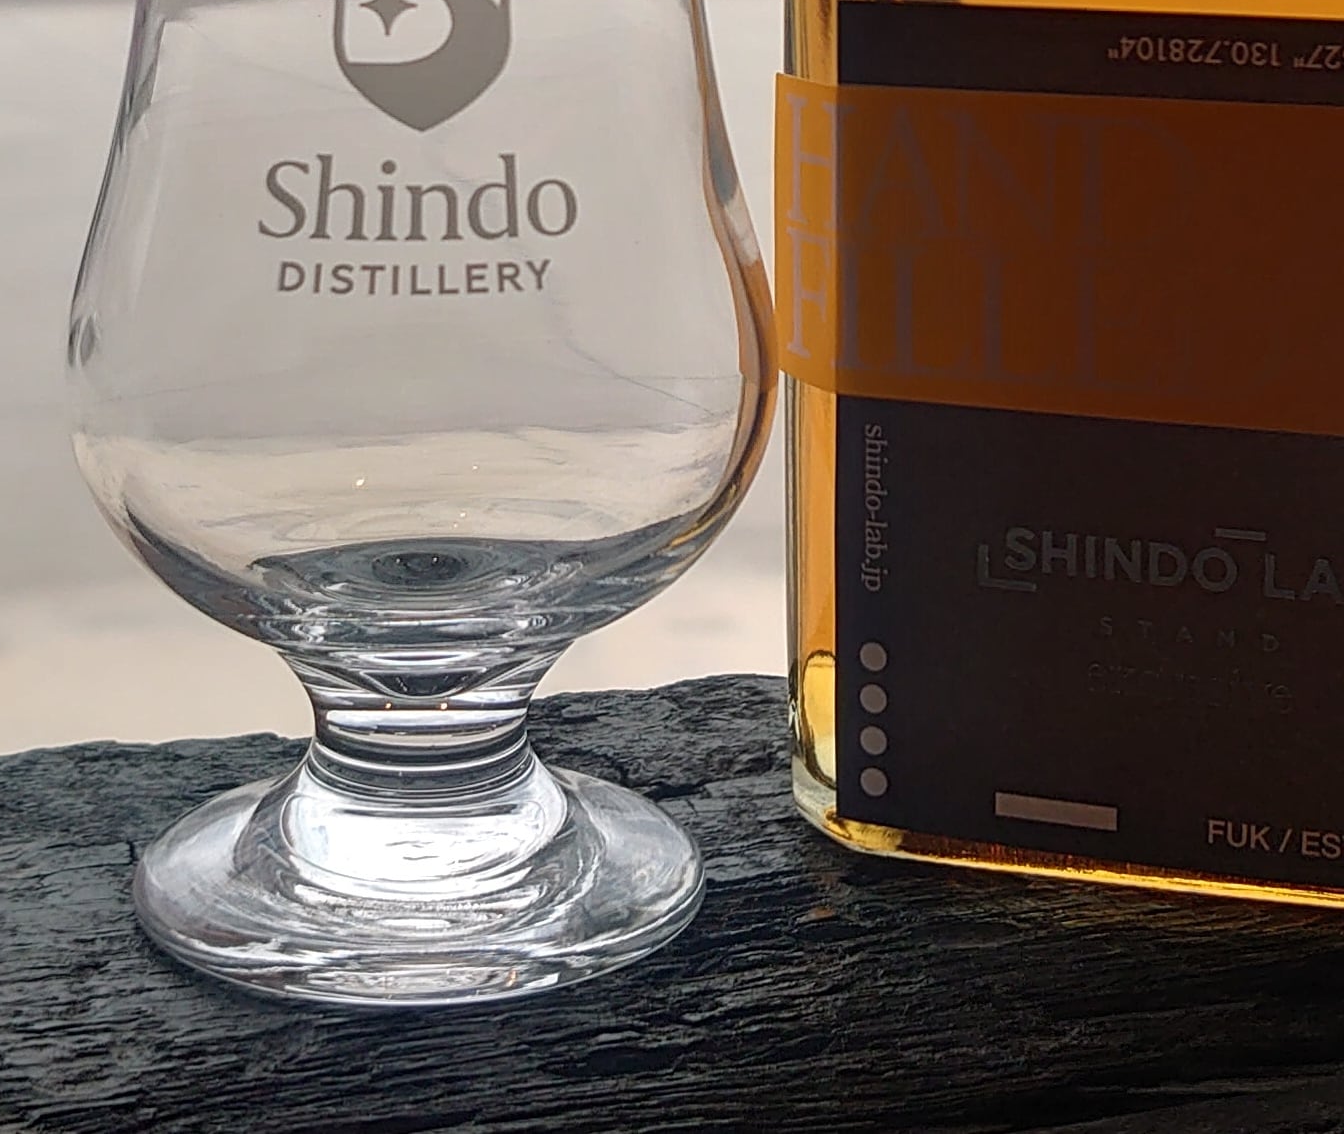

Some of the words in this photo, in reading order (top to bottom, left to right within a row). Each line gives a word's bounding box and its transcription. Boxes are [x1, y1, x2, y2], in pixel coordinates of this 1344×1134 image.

[258, 152, 578, 241] Shindo
[787, 96, 1199, 247] HAND
[277, 259, 551, 296] DISTILLERY
[861, 424, 888, 592] shindo-lab.jp
[1004, 526, 1239, 594] SHINDO
[1099, 616, 1281, 653] STAND
[1208, 819, 1271, 852] FUK
[1278, 828, 1294, 854] /
